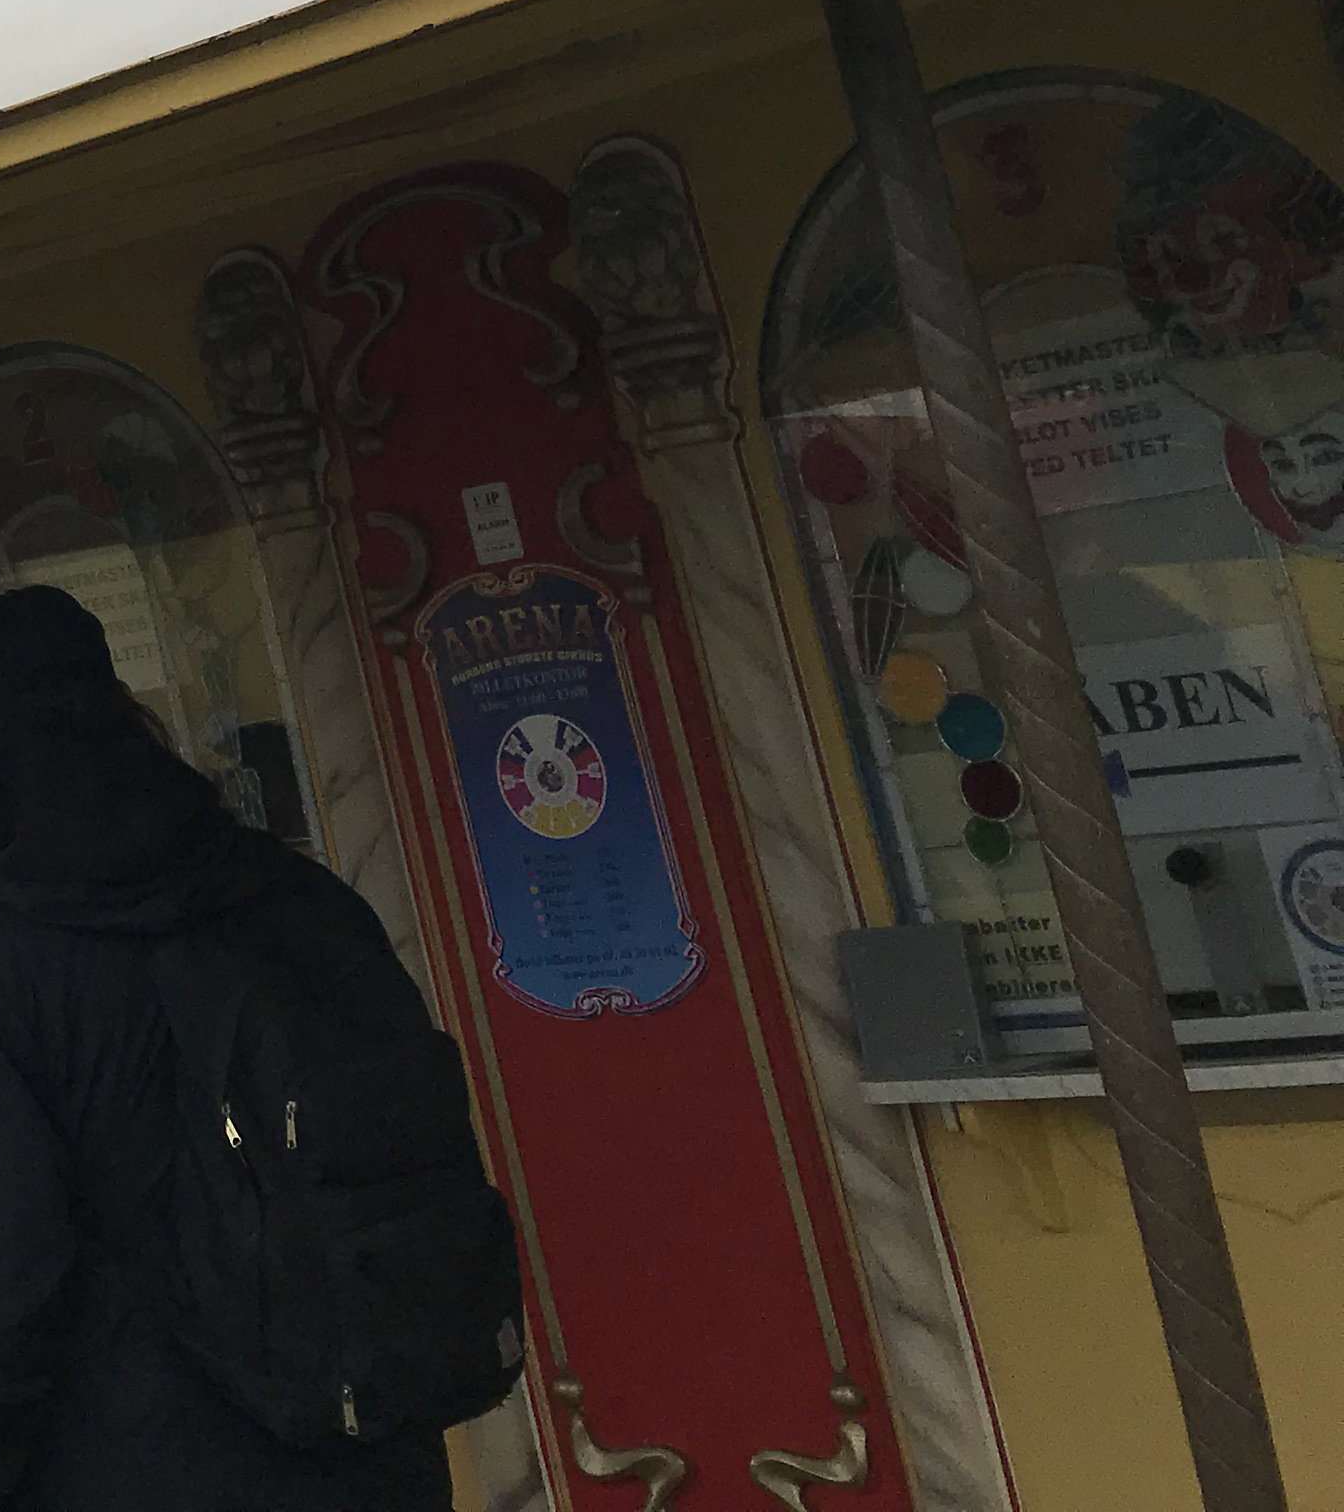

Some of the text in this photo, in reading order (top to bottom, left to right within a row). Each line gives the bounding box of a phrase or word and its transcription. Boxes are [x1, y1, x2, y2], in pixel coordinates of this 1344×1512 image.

[1016, 419, 1072, 445] LOT
[1025, 433, 1172, 477] ED TELTET
[442, 604, 601, 664] ARENA
